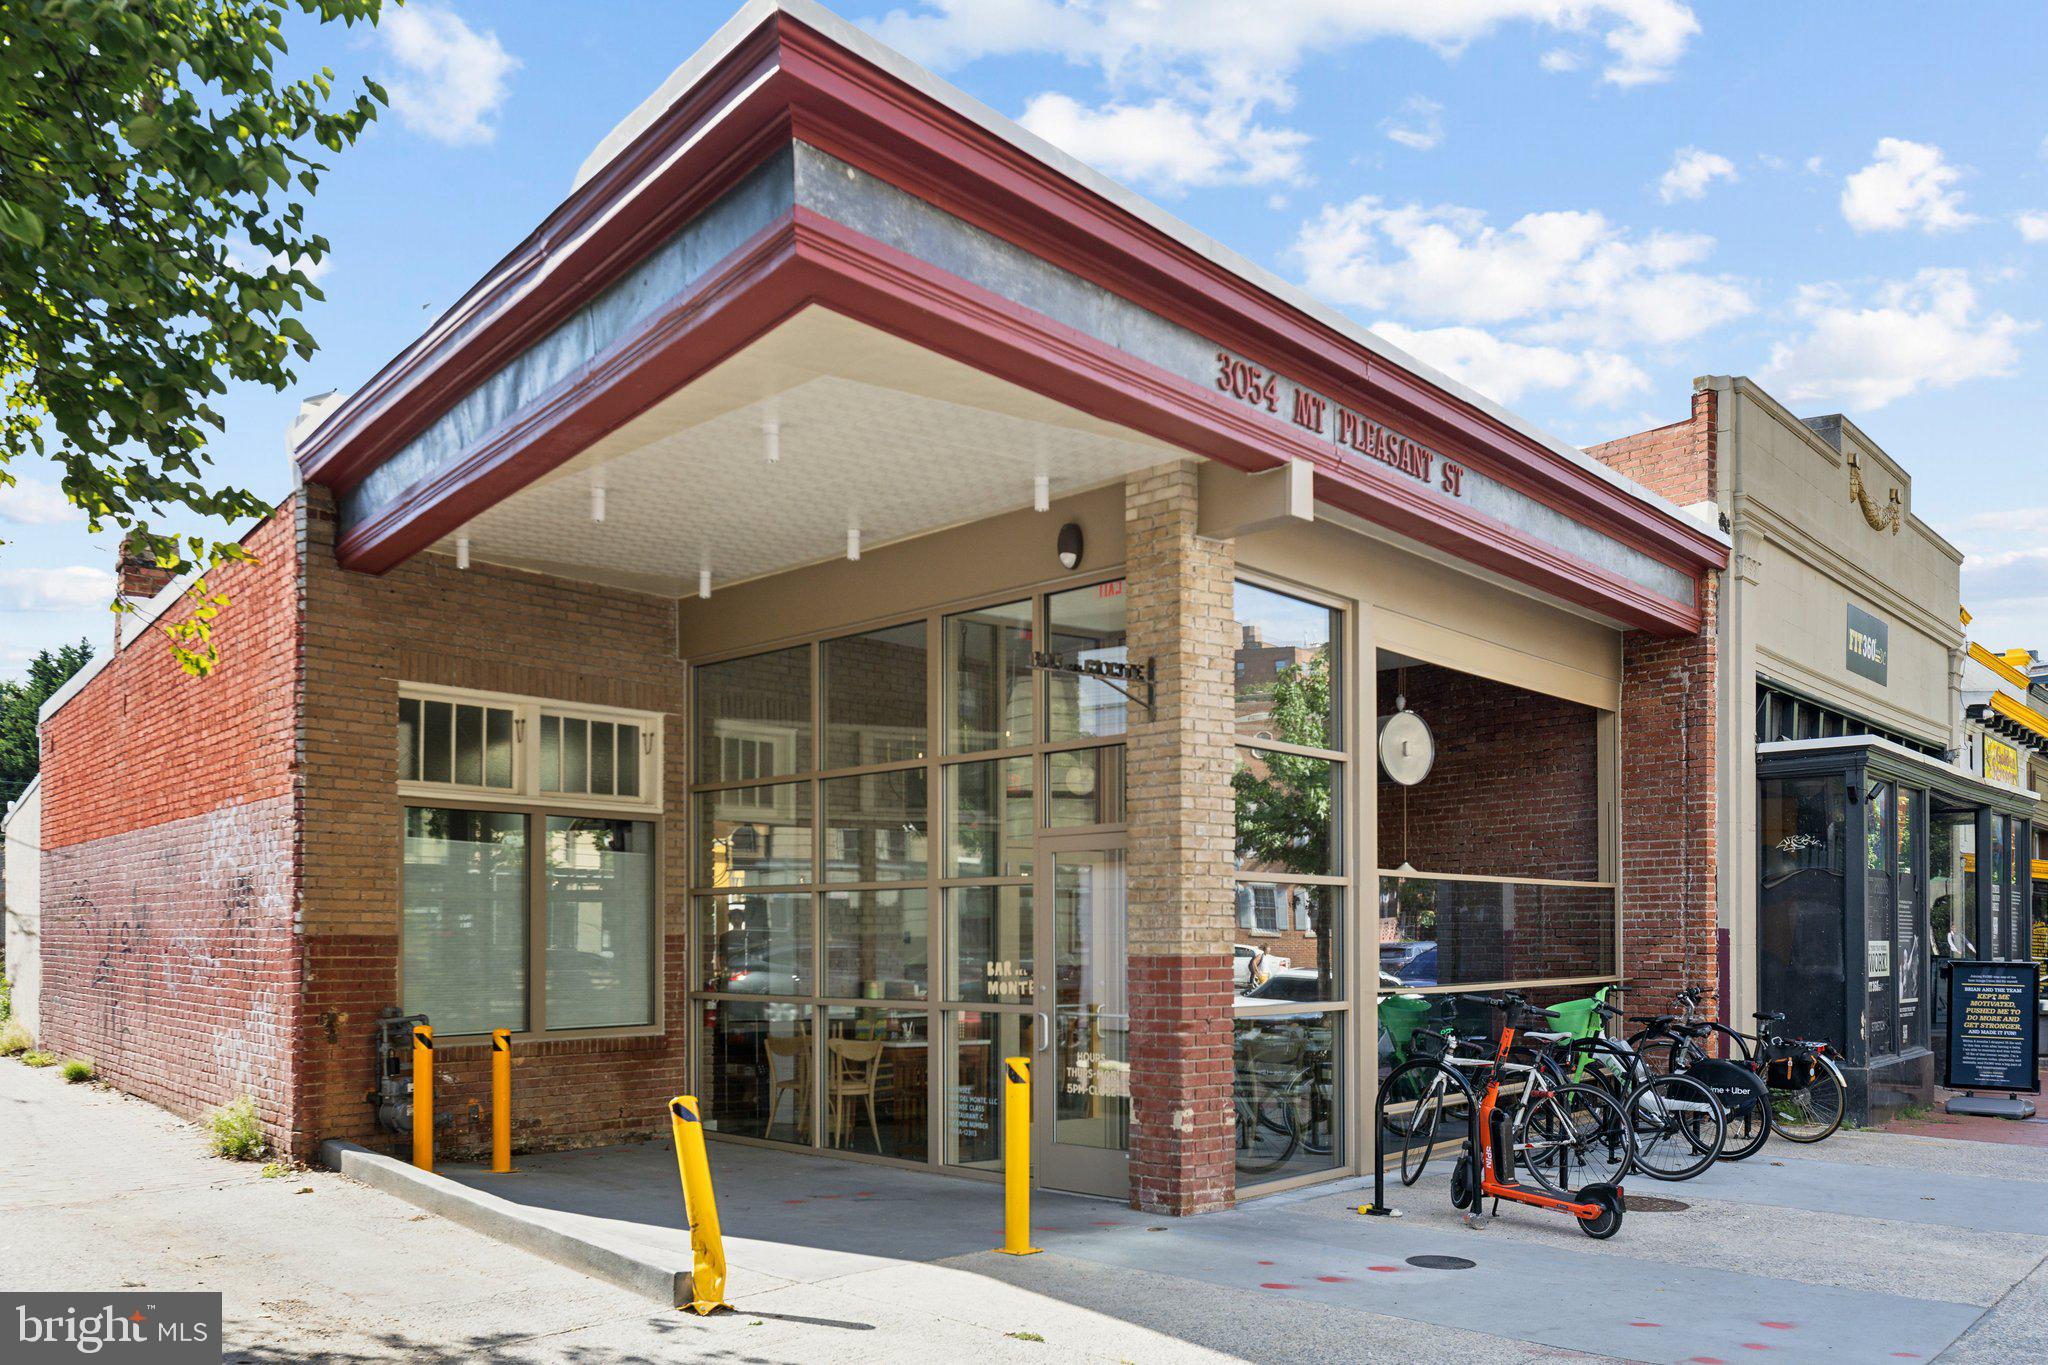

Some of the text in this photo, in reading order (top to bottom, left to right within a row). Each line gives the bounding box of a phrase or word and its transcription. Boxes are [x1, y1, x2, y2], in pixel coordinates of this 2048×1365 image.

[1217, 352, 1465, 497] 3054 MT PLEASANT ST
[987, 961, 1012, 977] BAR
[987, 980, 1034, 995] MONTE
[1077, 1051, 1106, 1062] HOURS
[1731, 1086, 1751, 1095] Uber
[989, 1097, 998, 1106] LLC
